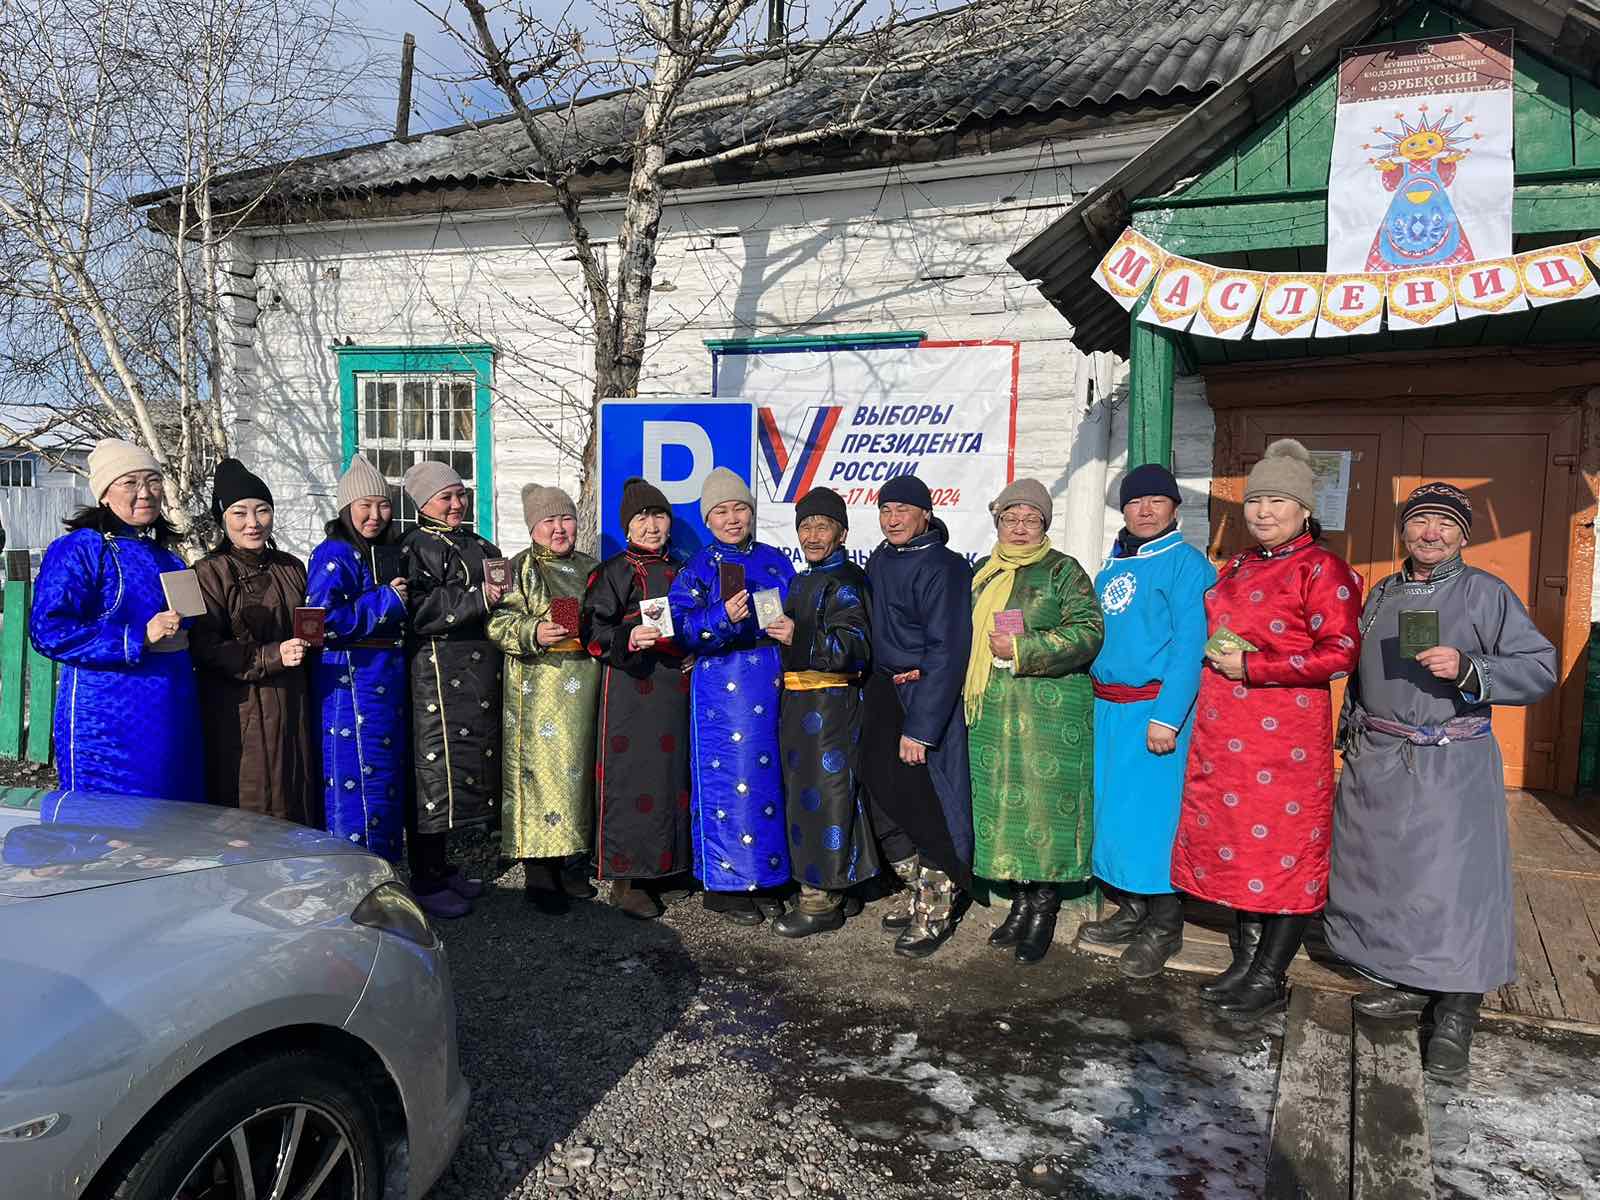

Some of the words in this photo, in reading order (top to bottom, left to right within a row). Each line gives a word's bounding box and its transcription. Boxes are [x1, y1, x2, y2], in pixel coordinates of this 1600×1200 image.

[1364, 66, 1421, 78] БЮДЖЕТНОЕ
[1109, 246, 1577, 316] МАСЛЕНИЦ
[852, 404, 954, 426] ВЫБОРЫ
[840, 432, 983, 456] ПРЕЗИДЕНТА
[643, 420, 714, 504] P
[829, 461, 919, 481] РОССИИ
[929, 488, 961, 506] 024
